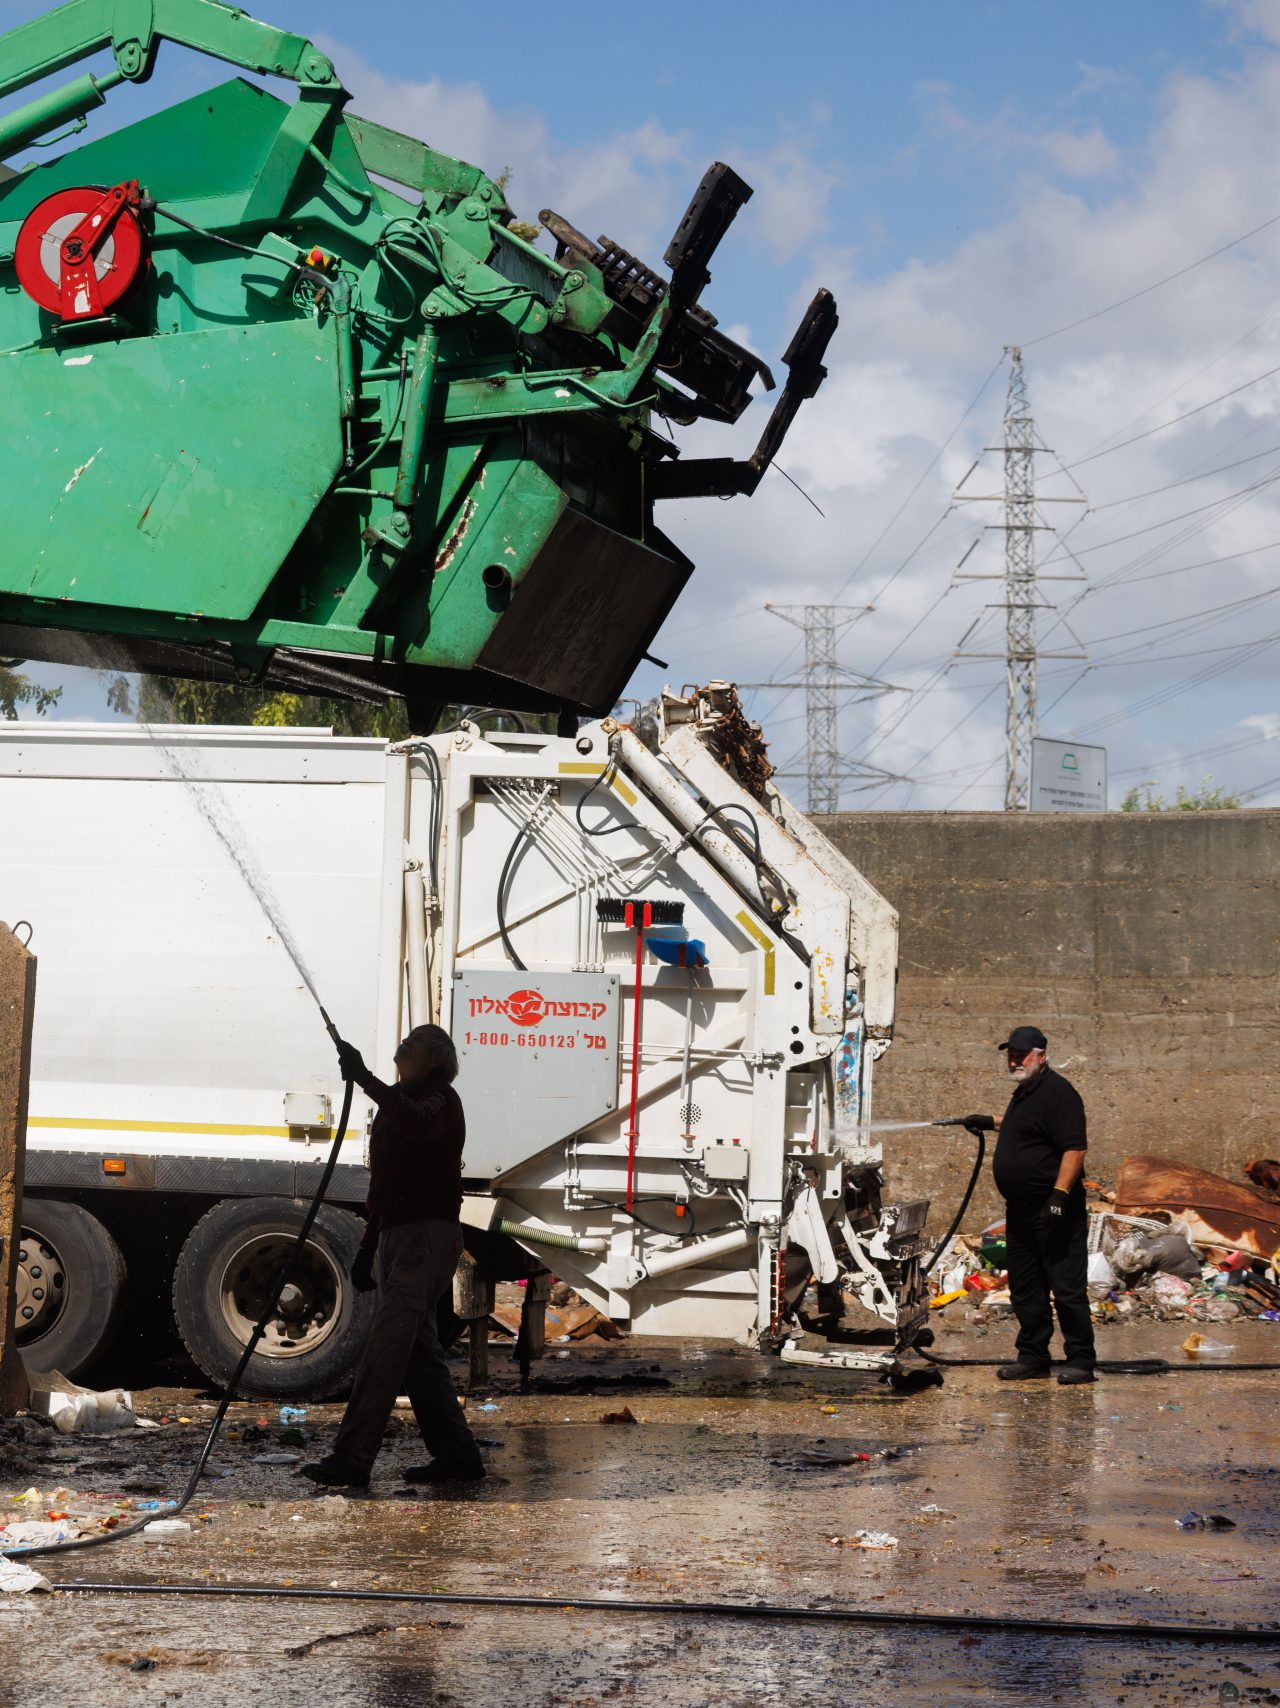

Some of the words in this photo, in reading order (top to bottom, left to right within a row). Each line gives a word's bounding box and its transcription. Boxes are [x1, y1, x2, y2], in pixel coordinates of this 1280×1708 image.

[468, 995, 510, 1018] אלון
[542, 1001, 607, 1021] קבוצת
[465, 1031, 575, 1049] 1-800-650123
